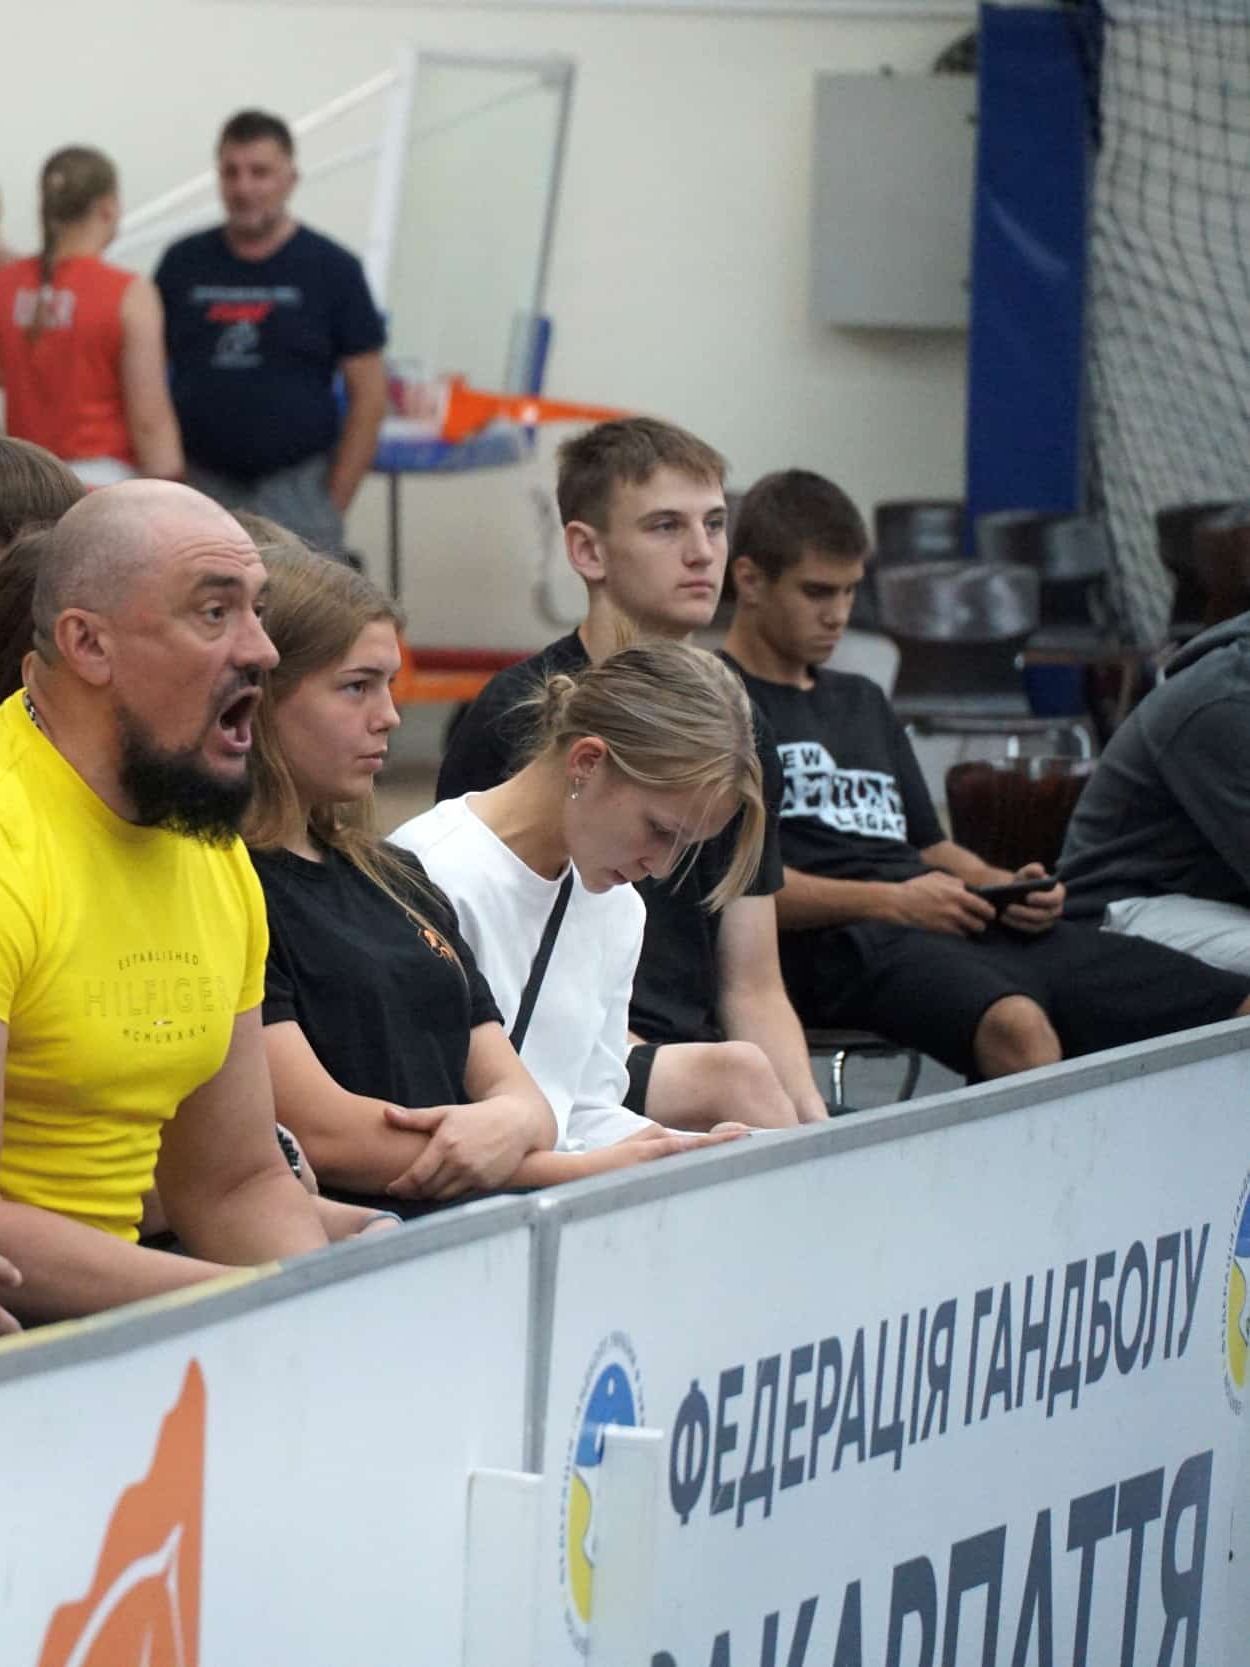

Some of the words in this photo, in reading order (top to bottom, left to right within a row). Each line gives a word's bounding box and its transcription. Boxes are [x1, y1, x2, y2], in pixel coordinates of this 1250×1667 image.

[118, 950, 200, 971] ESTABLISHED
[669, 1297, 958, 1528] ФЕДЕРАЦІЯ
[963, 1223, 1211, 1425] ГАНДБОЛУ
[650, 1450, 1213, 1667] ПАТТЯ
